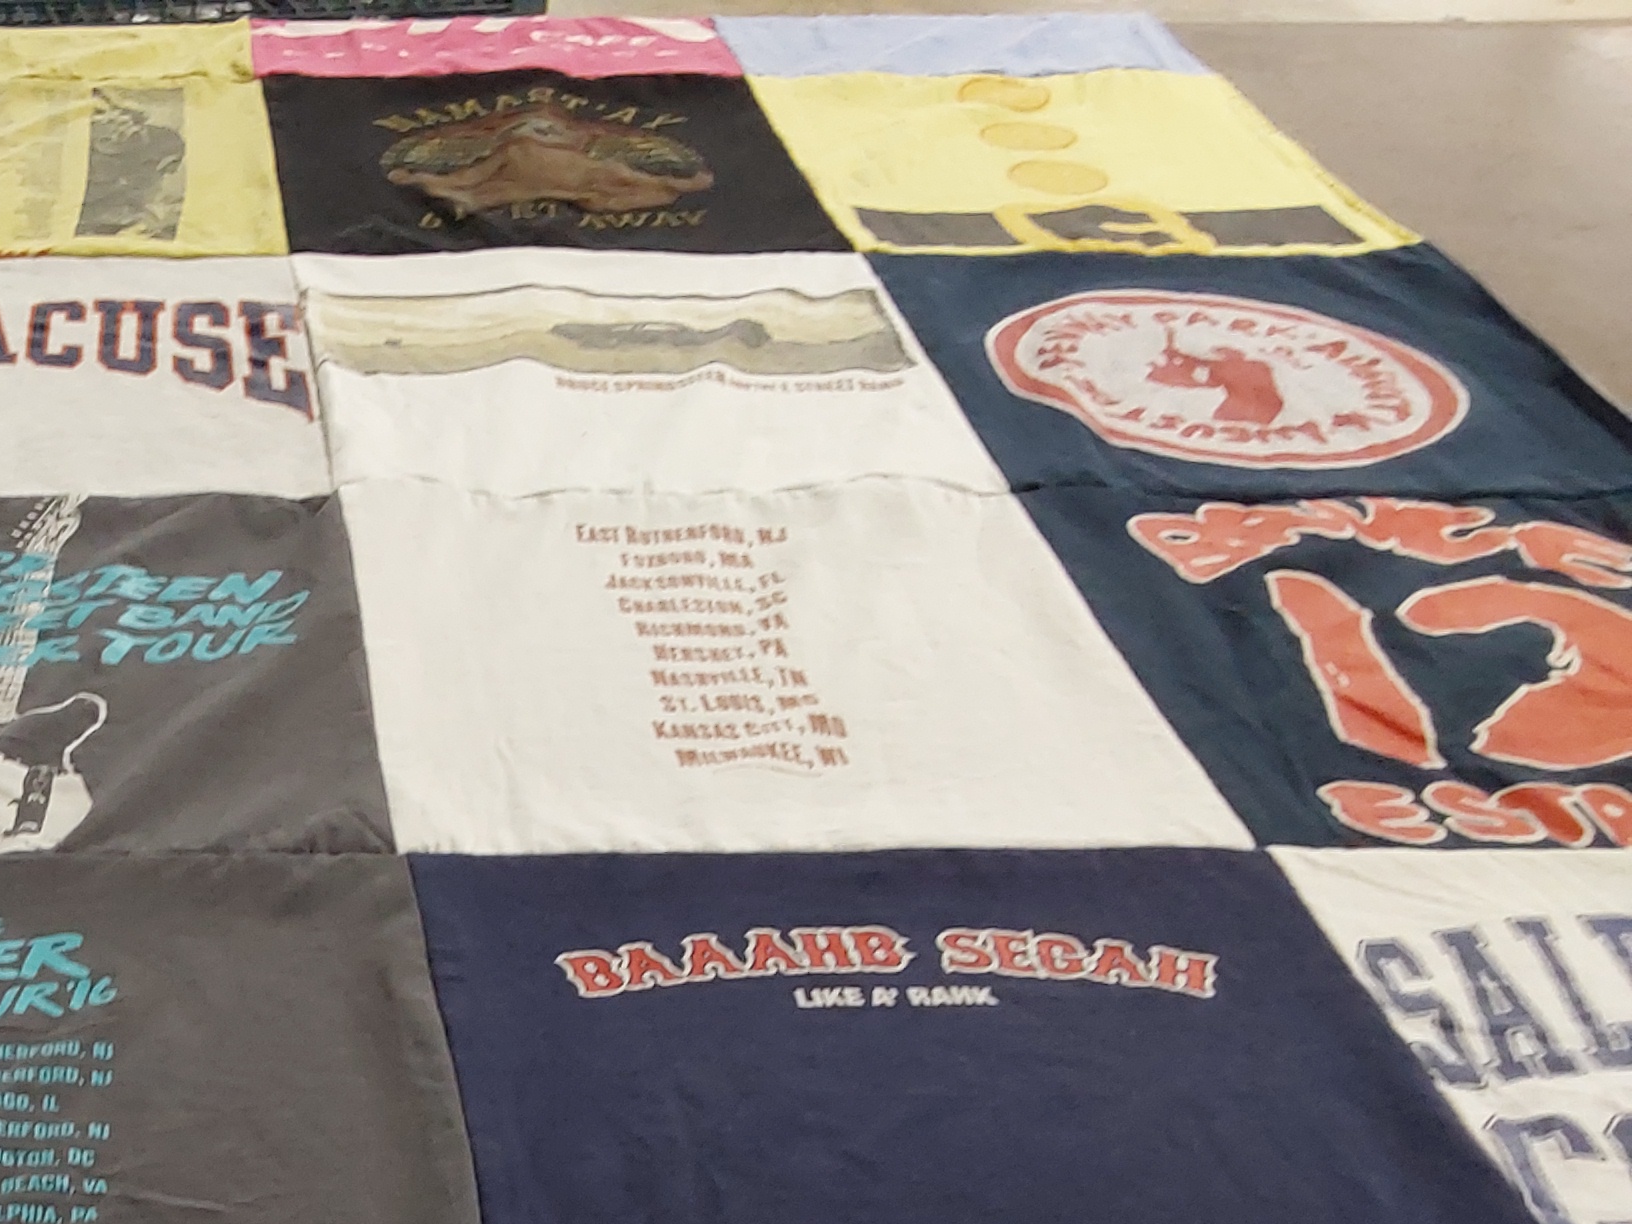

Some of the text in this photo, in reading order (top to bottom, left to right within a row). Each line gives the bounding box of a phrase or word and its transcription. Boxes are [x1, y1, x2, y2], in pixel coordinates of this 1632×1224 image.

[117, 590, 310, 630] BAND
[98, 619, 298, 667] TOUR
[1264, 568, 1632, 770] 12
[793, 985, 866, 1008] LIKE
[93, 1041, 113, 1060] NJ
[91, 1069, 113, 1086] NJ
[42, 1095, 59, 1113] IL
[88, 1122, 110, 1140] NJ
[68, 1147, 95, 1167] DC
[82, 1177, 108, 1194] VA
[71, 1206, 98, 1223] PA
